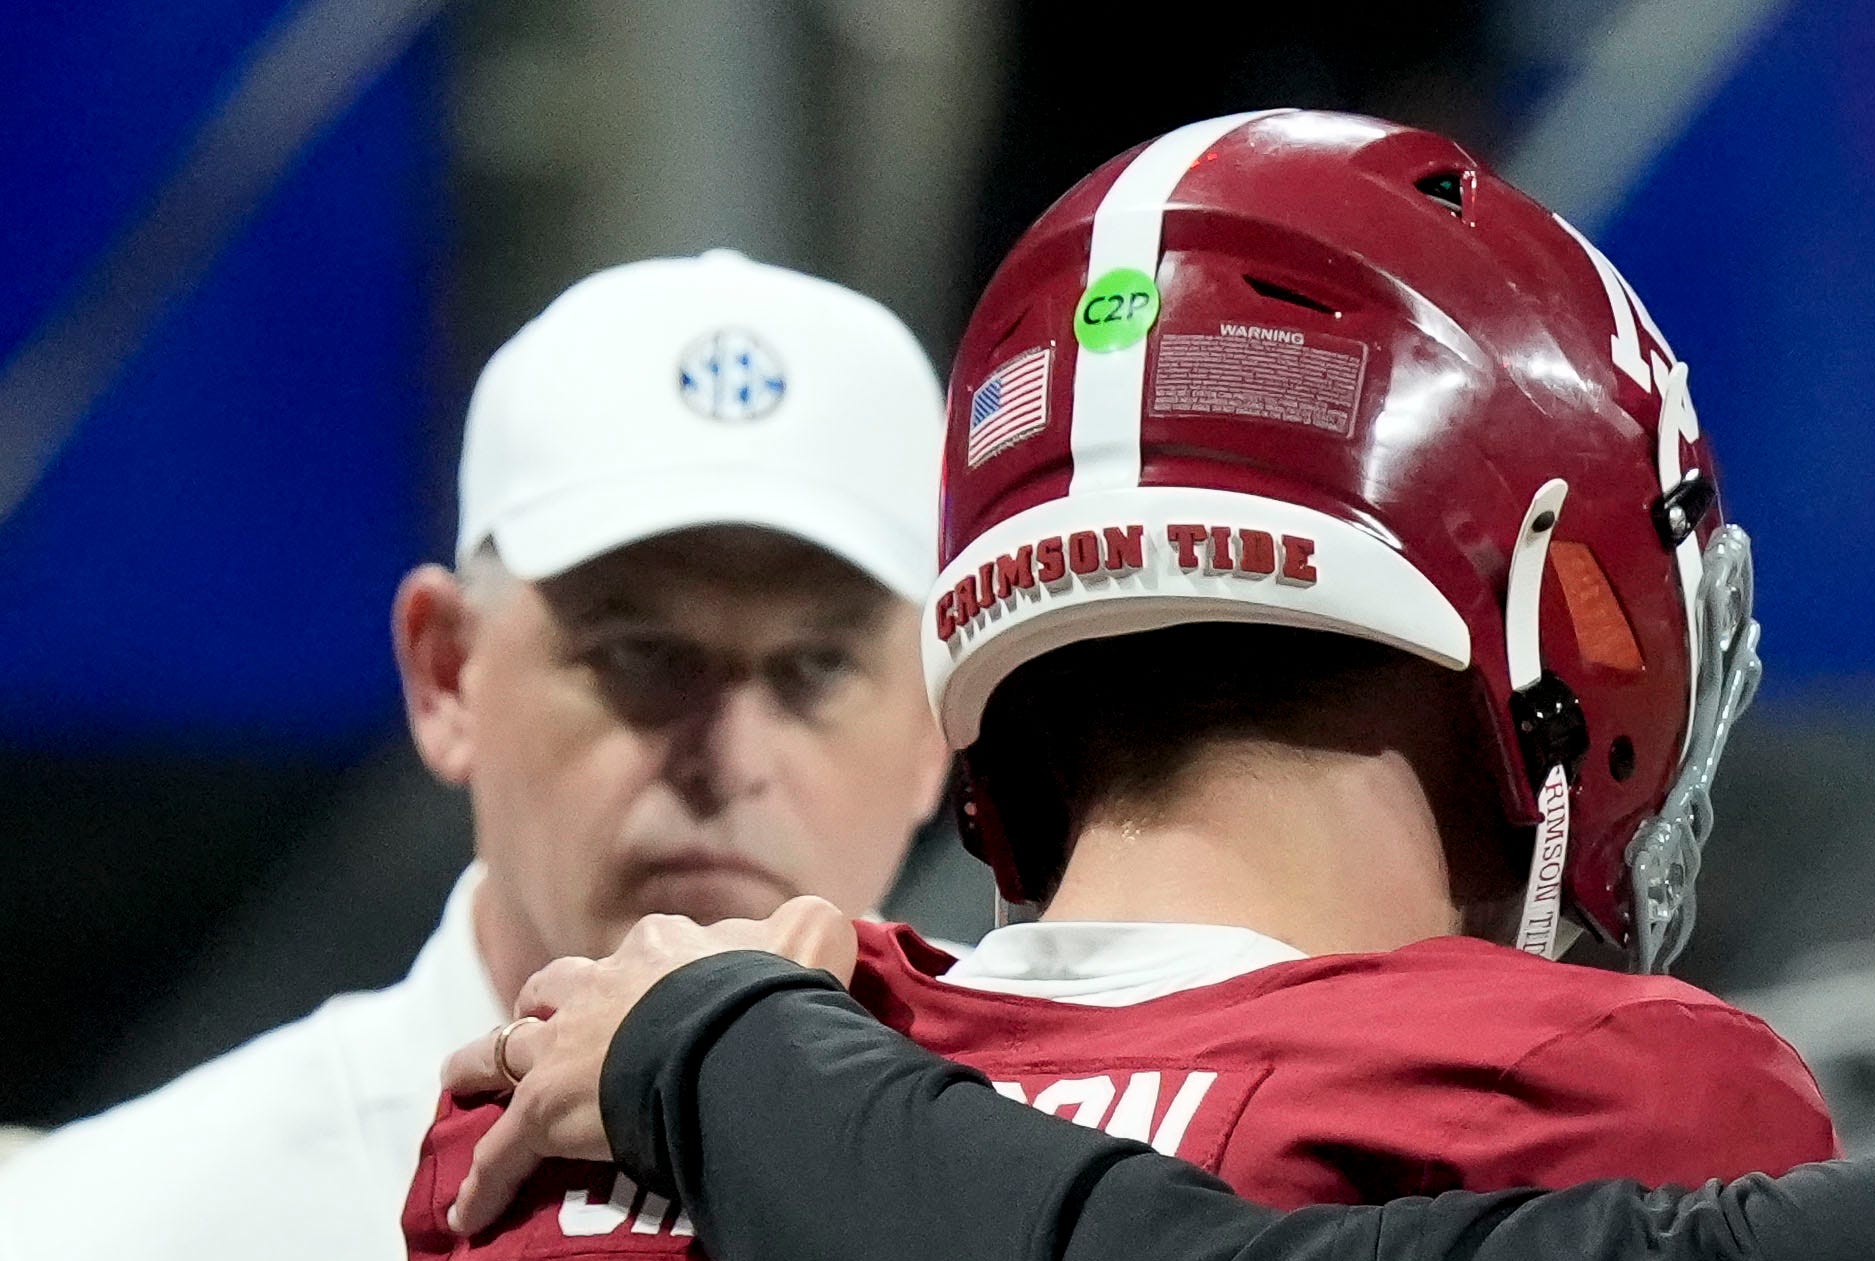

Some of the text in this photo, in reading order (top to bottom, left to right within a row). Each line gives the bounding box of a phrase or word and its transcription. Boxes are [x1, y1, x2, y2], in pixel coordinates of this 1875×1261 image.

[1082, 291, 1150, 325] C2P
[1219, 323, 1305, 345] WARNING
[936, 524, 1318, 642] CRIMSON TIDE
[1534, 768, 1566, 903] RIMSON
